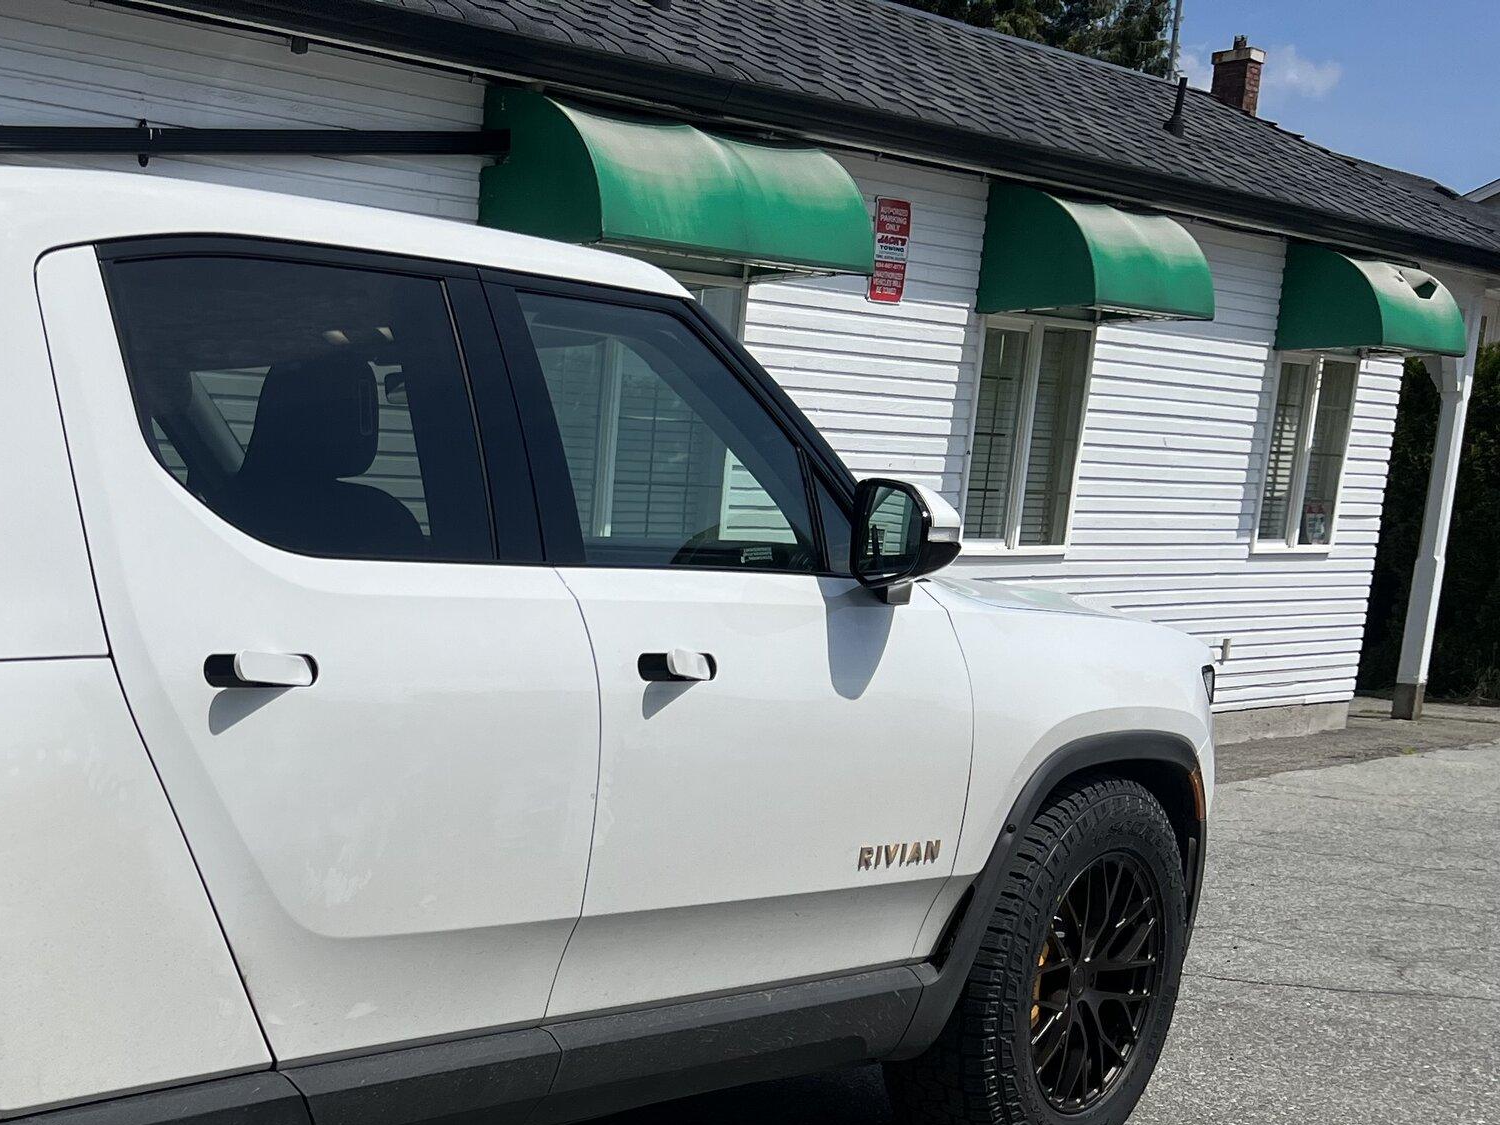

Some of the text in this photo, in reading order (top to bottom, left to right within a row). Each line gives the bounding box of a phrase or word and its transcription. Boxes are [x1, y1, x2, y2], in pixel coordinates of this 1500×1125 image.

[880, 215, 907, 225] PARKING
[886, 224, 901, 232] ONLY
[880, 245, 904, 253] TOWING
[858, 839, 941, 871] RIVIAN
